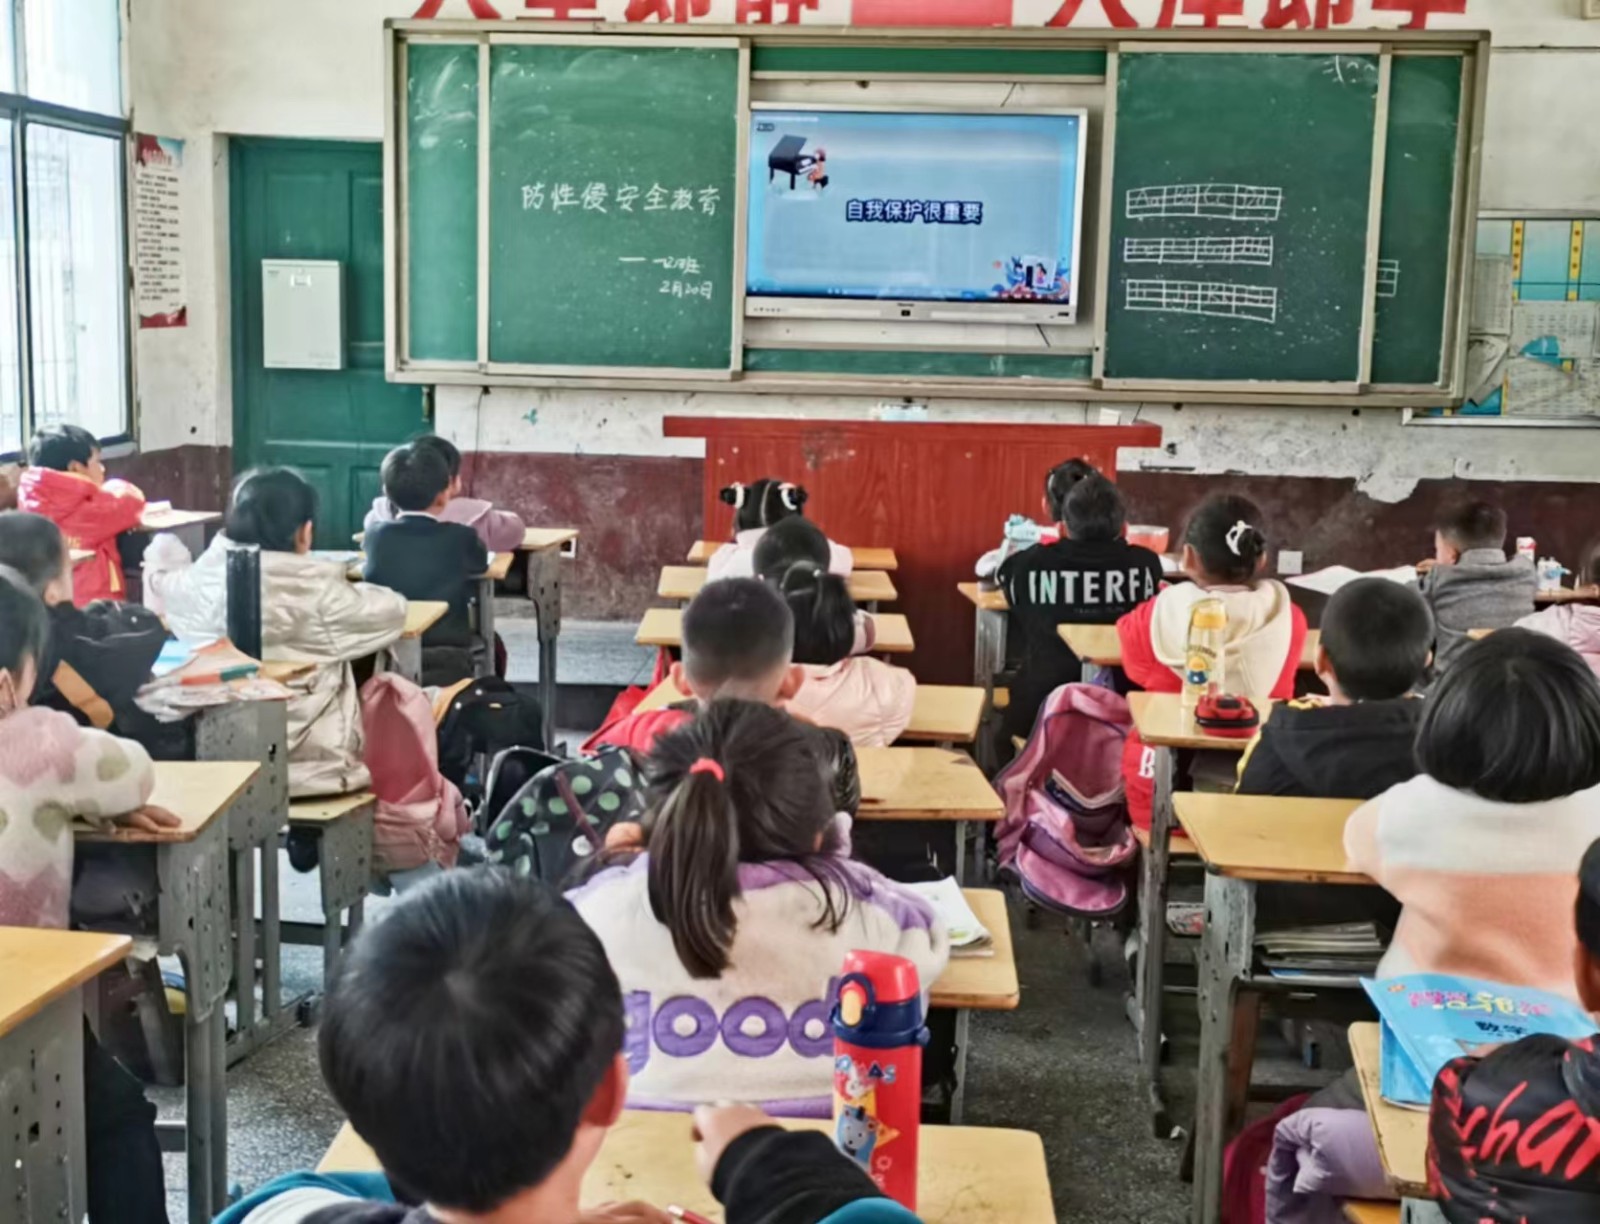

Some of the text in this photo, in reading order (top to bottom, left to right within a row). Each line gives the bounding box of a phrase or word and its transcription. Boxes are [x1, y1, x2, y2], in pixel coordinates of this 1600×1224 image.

[521, 182, 721, 217] 防性侵安全教育
[846, 199, 983, 225] 自我保护很重要
